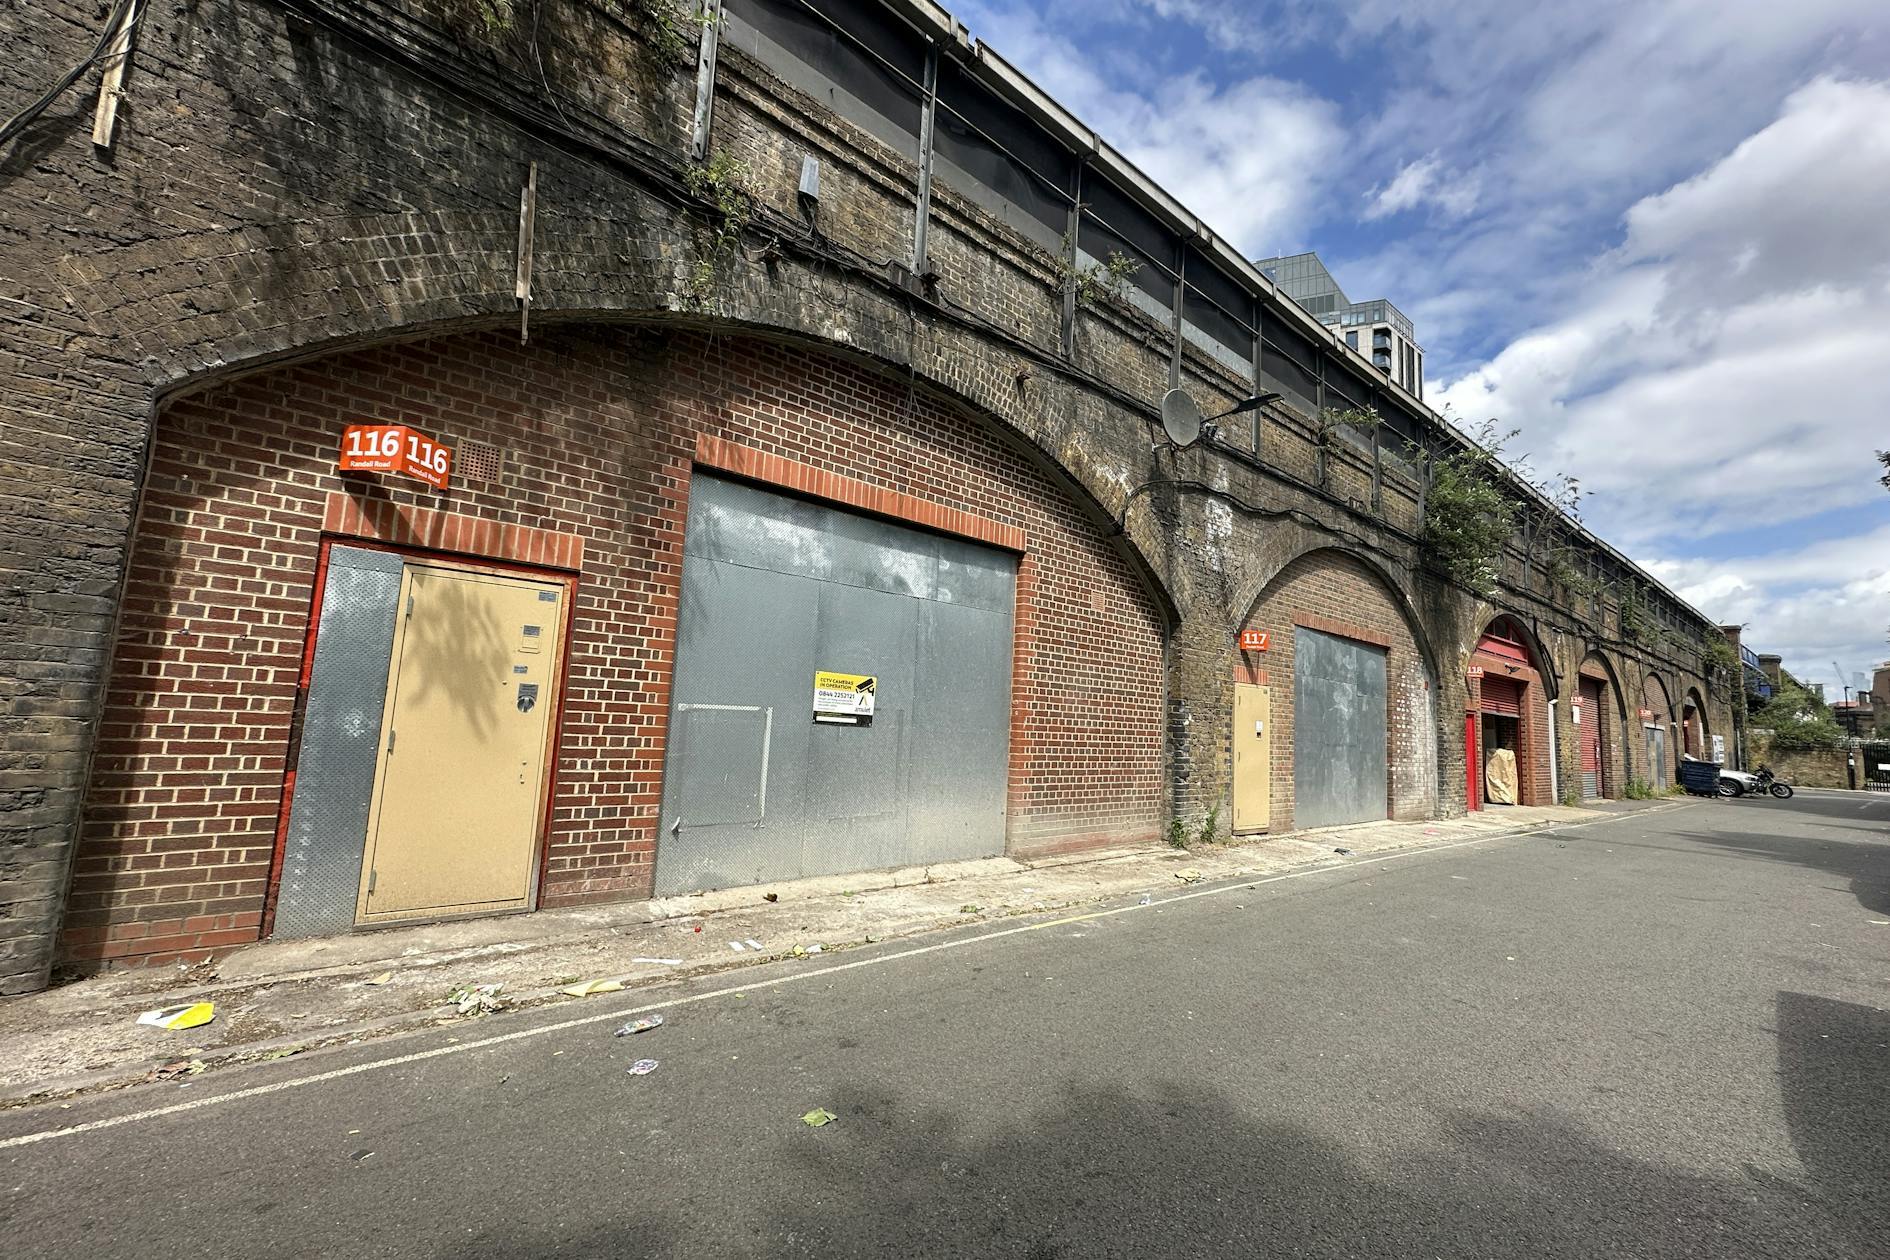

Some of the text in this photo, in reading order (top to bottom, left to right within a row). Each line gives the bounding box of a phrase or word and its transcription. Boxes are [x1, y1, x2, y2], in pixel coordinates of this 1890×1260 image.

[346, 430, 400, 457] 116
[406, 435, 448, 474] 116
[350, 460, 391, 468] Randall Road
[427, 472, 441, 484] Road
[1243, 633, 1267, 645] 117
[1467, 666, 1483, 674] 118
